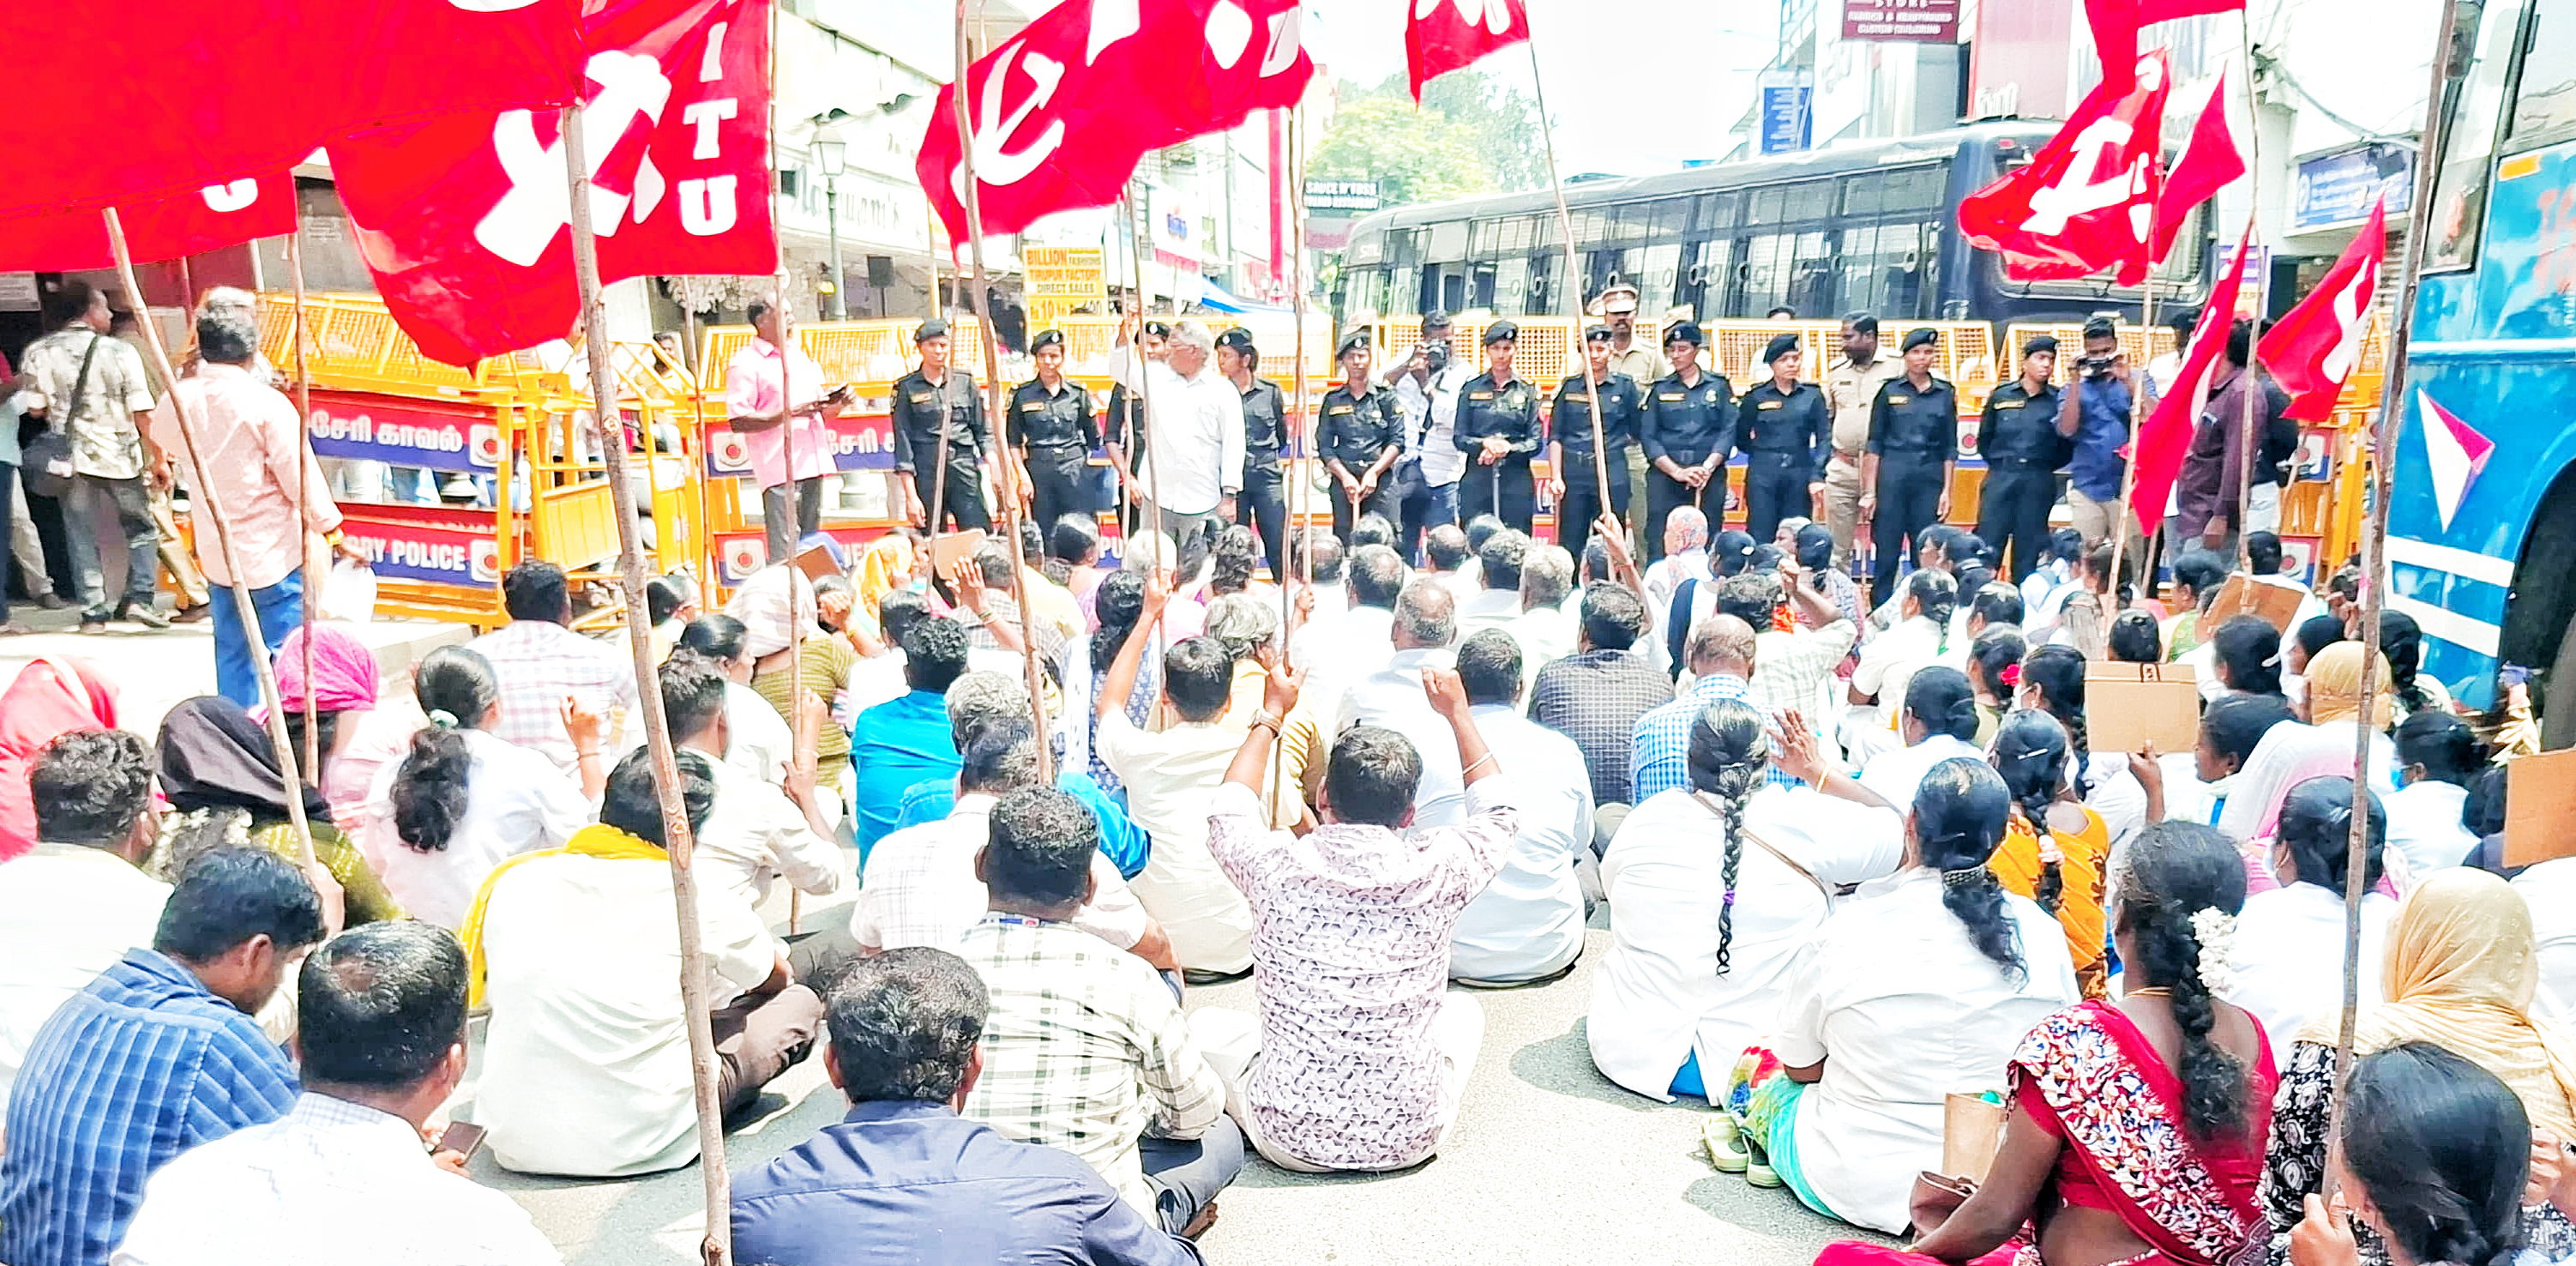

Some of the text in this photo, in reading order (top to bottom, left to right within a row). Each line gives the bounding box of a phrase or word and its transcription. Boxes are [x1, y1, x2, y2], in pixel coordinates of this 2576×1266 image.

[677, 0, 737, 236] ITU
[1026, 249, 1068, 266] BILLION
[1065, 268, 1101, 281] FACTORY
[1037, 283, 1066, 293] DIRECT
[310, 409, 464, 453] சேரி காவல்
[391, 539, 466, 571] POLICE
